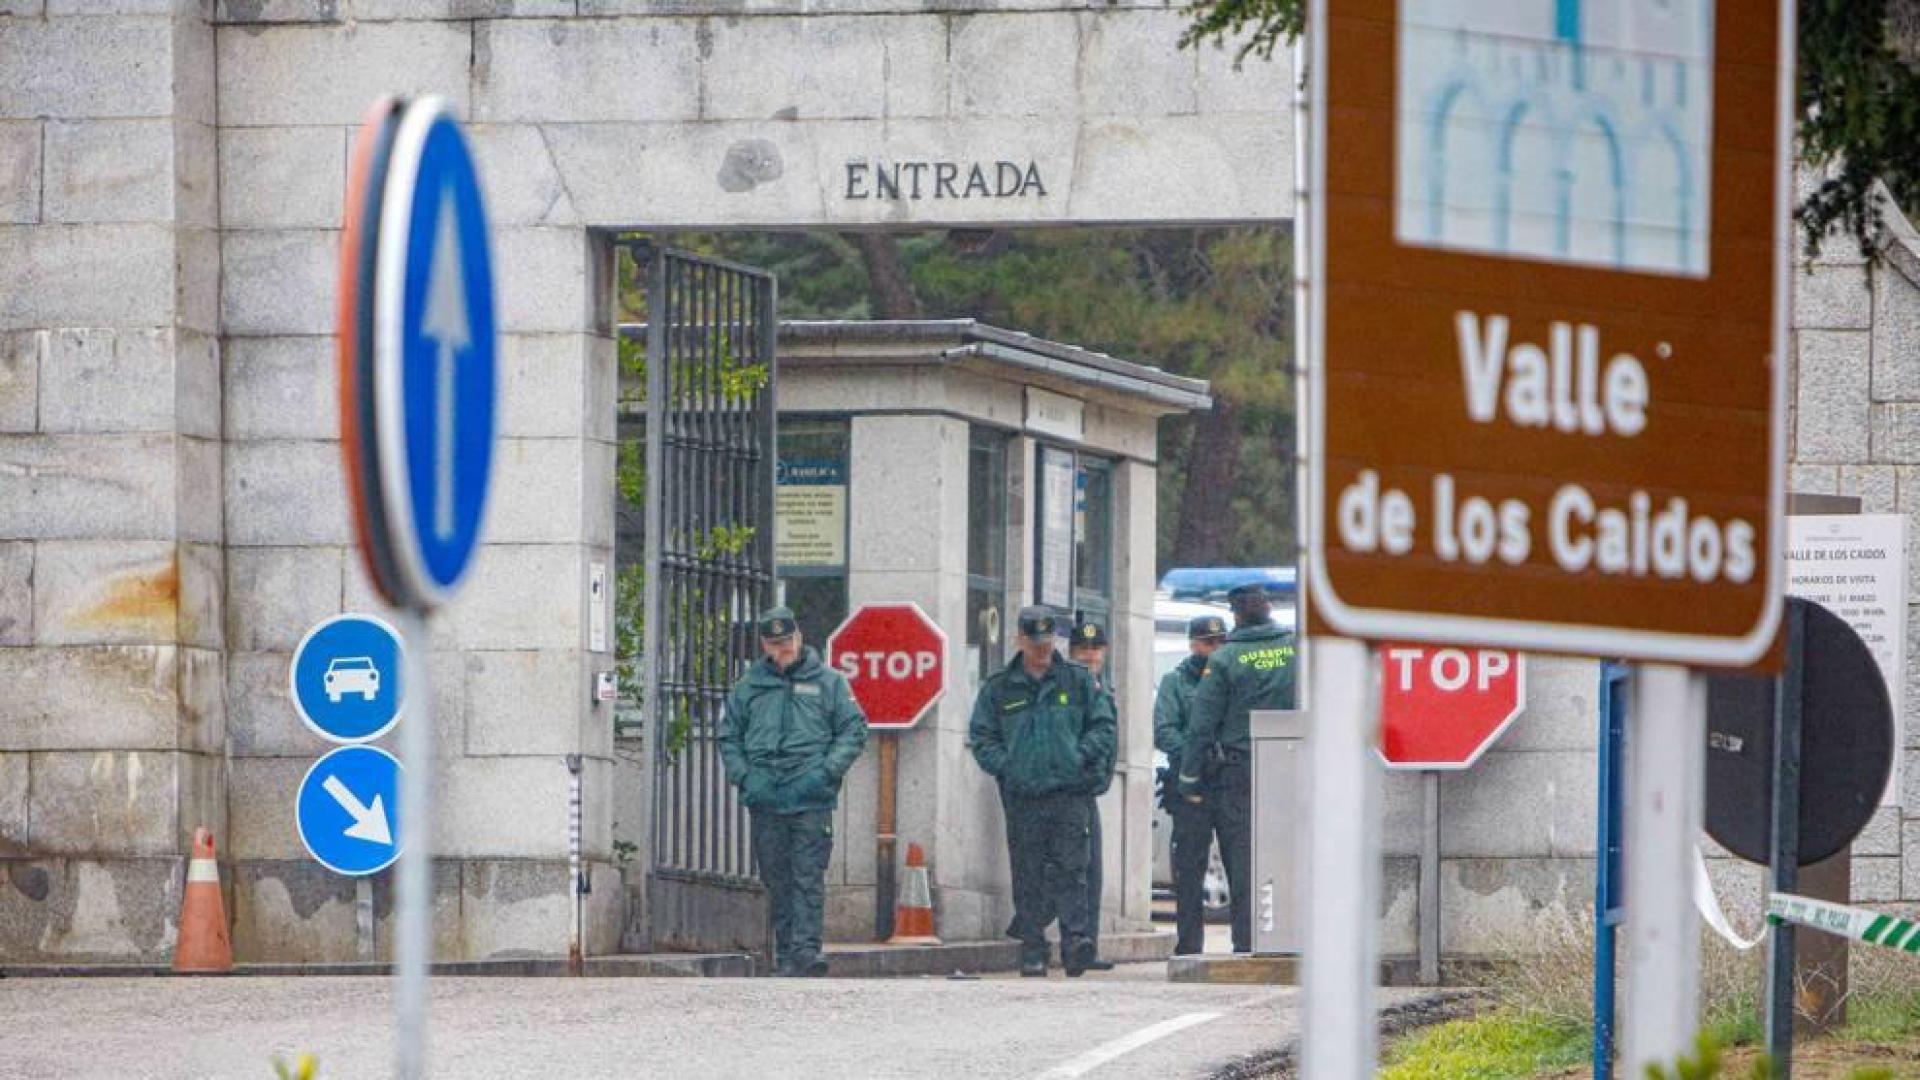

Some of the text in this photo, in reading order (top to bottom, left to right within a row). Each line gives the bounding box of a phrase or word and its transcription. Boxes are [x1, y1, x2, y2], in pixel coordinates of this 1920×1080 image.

[845, 160, 1048, 200] ENTRADA
[1455, 310, 1650, 437] Valle
[1337, 468, 1757, 584] de los Caidos
[1783, 550, 1810, 561] VALLE
[1814, 550, 1826, 561] DE
[1830, 550, 1847, 560] LOS
[1791, 575, 1834, 585] HORARIOS
[1836, 575, 1847, 585] DE
[839, 651, 938, 680] STOP
[1238, 645, 1296, 664] GUARDIA
[1254, 657, 1287, 670] CIVIL
[1389, 648, 1509, 692] TOP
